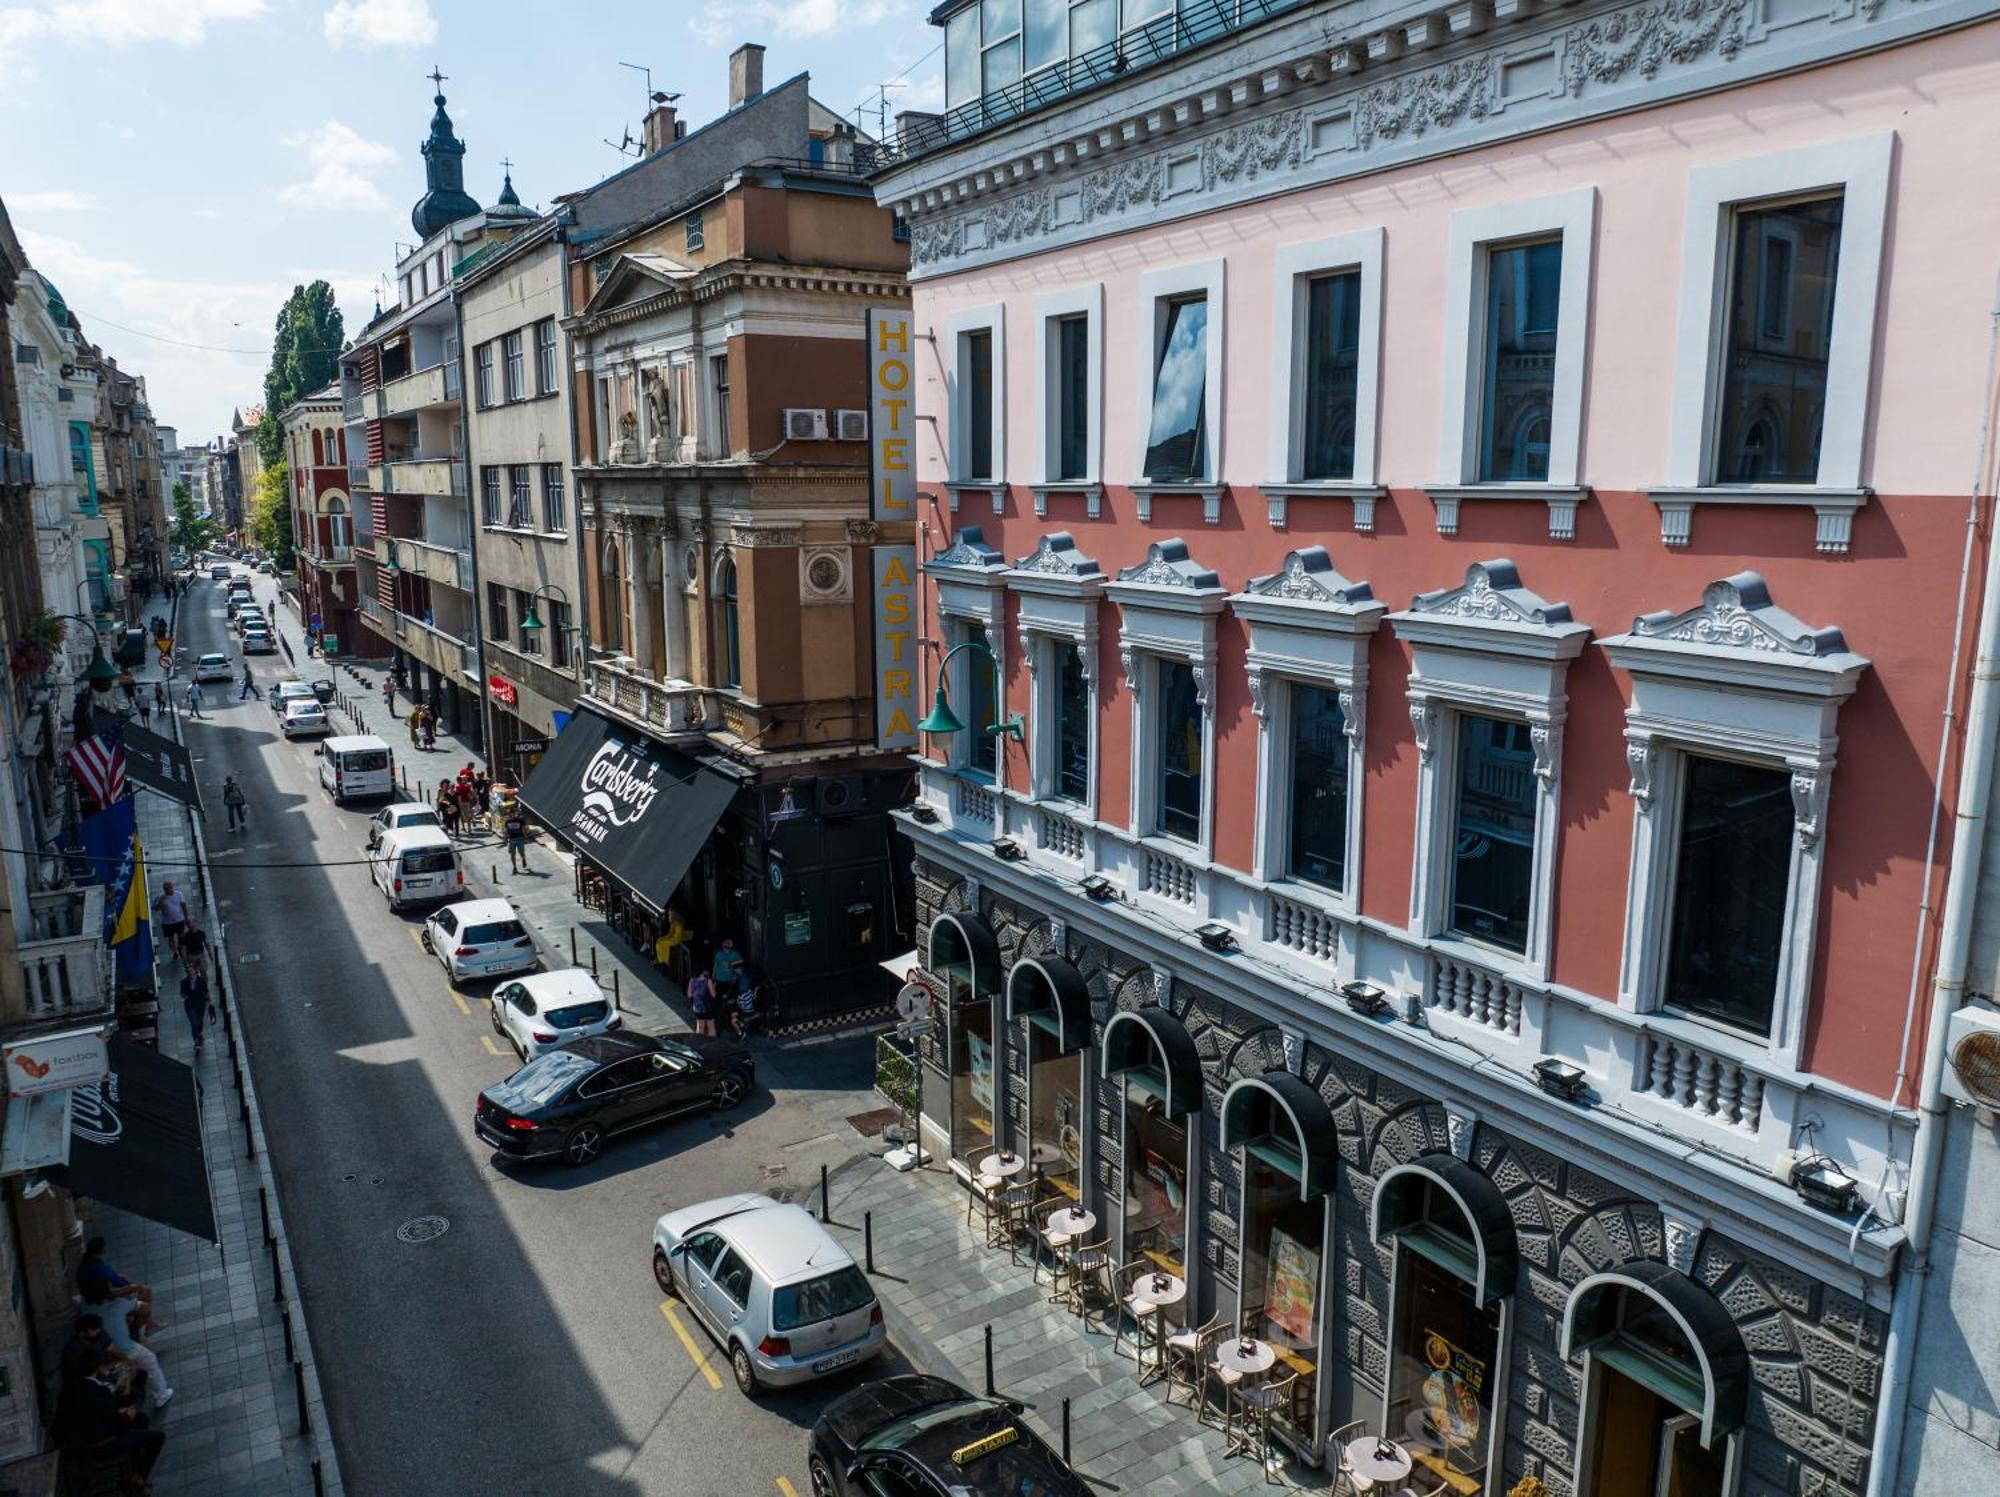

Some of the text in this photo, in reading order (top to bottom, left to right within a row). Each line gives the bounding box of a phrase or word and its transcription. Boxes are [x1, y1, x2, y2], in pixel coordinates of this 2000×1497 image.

[878, 319, 909, 510] HOTEL
[880, 555, 914, 739] ASTRA
[514, 742, 542, 752] MONA
[581, 738, 660, 826] Carlsberg
[571, 810, 609, 844] DENMARK
